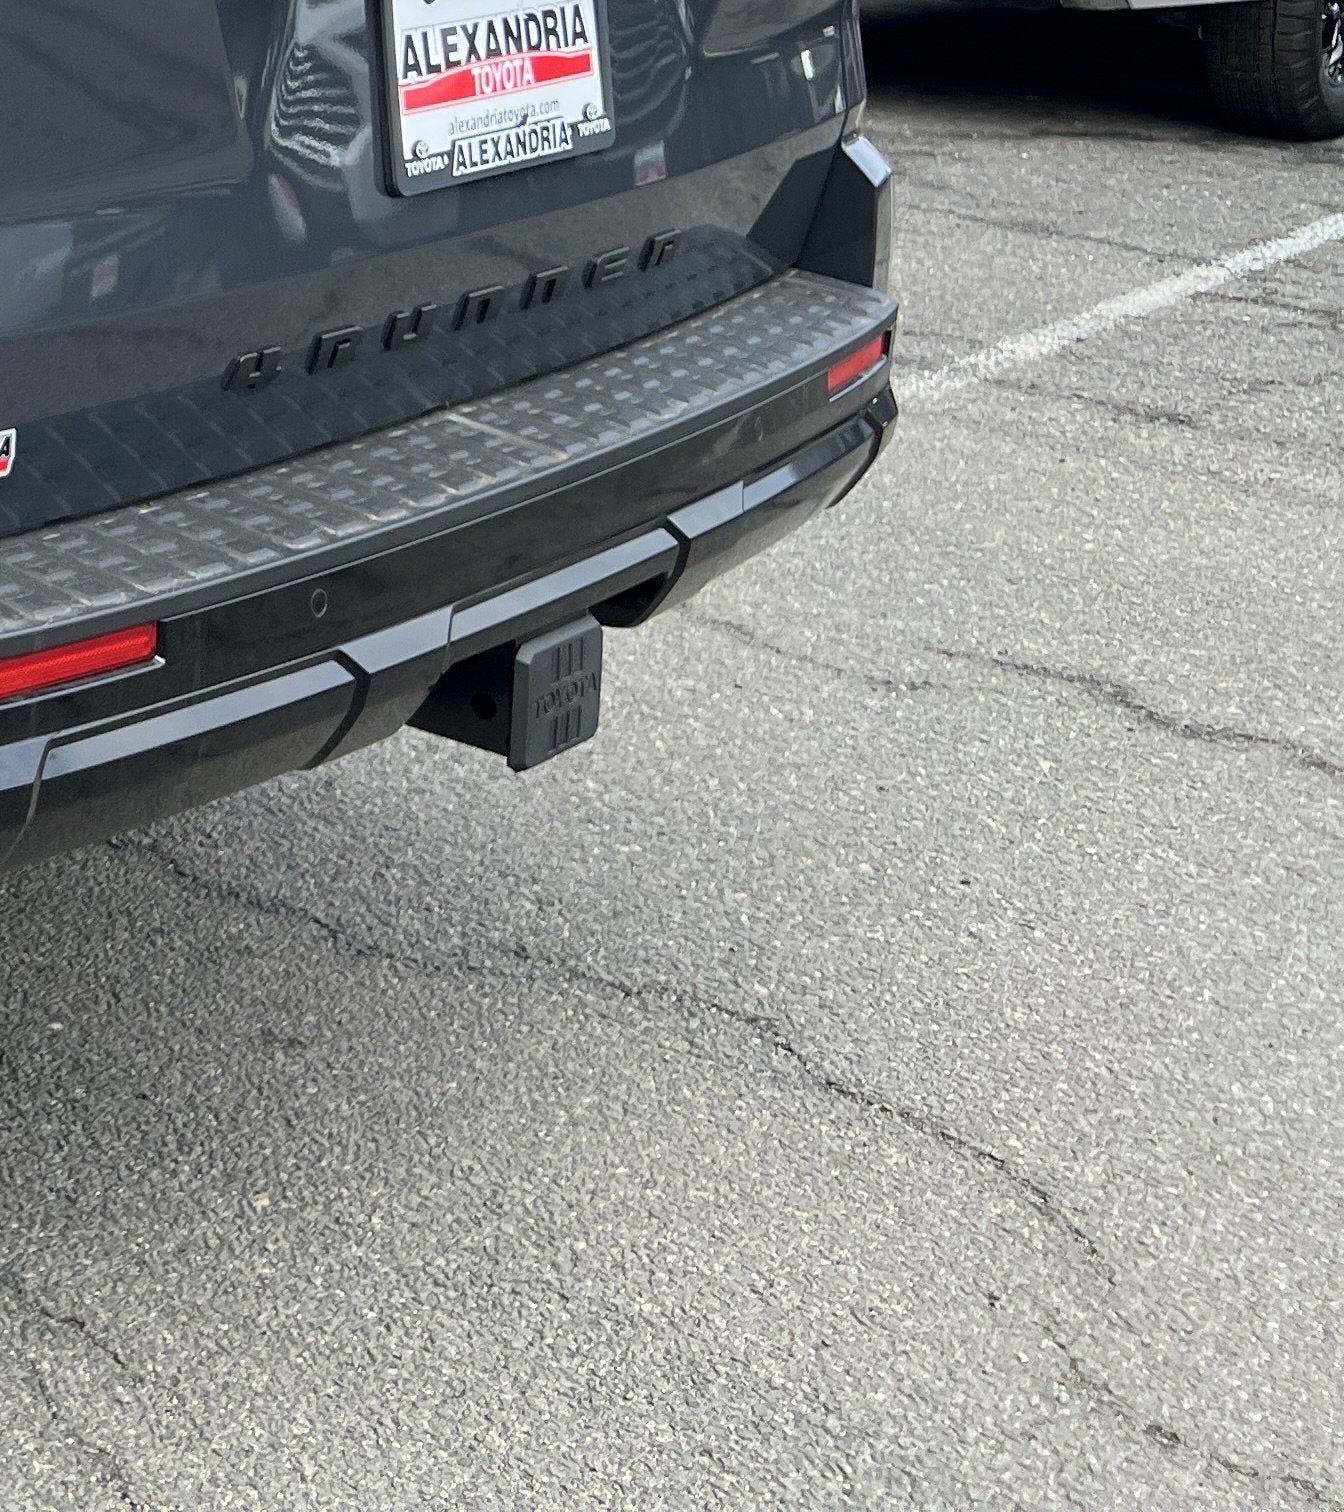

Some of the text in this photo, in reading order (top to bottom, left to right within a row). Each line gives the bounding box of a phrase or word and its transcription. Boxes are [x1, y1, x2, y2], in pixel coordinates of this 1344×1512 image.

[401, 3, 588, 81] ALEXANDRIA
[471, 56, 537, 96] TOYOTA
[448, 98, 560, 136] alexandriatoyota.com
[405, 117, 611, 177] TOYOTA ALEXANDRIA TOYOTA
[220, 228, 682, 392] 4RUNNER
[535, 671, 598, 719] TOYOTA
